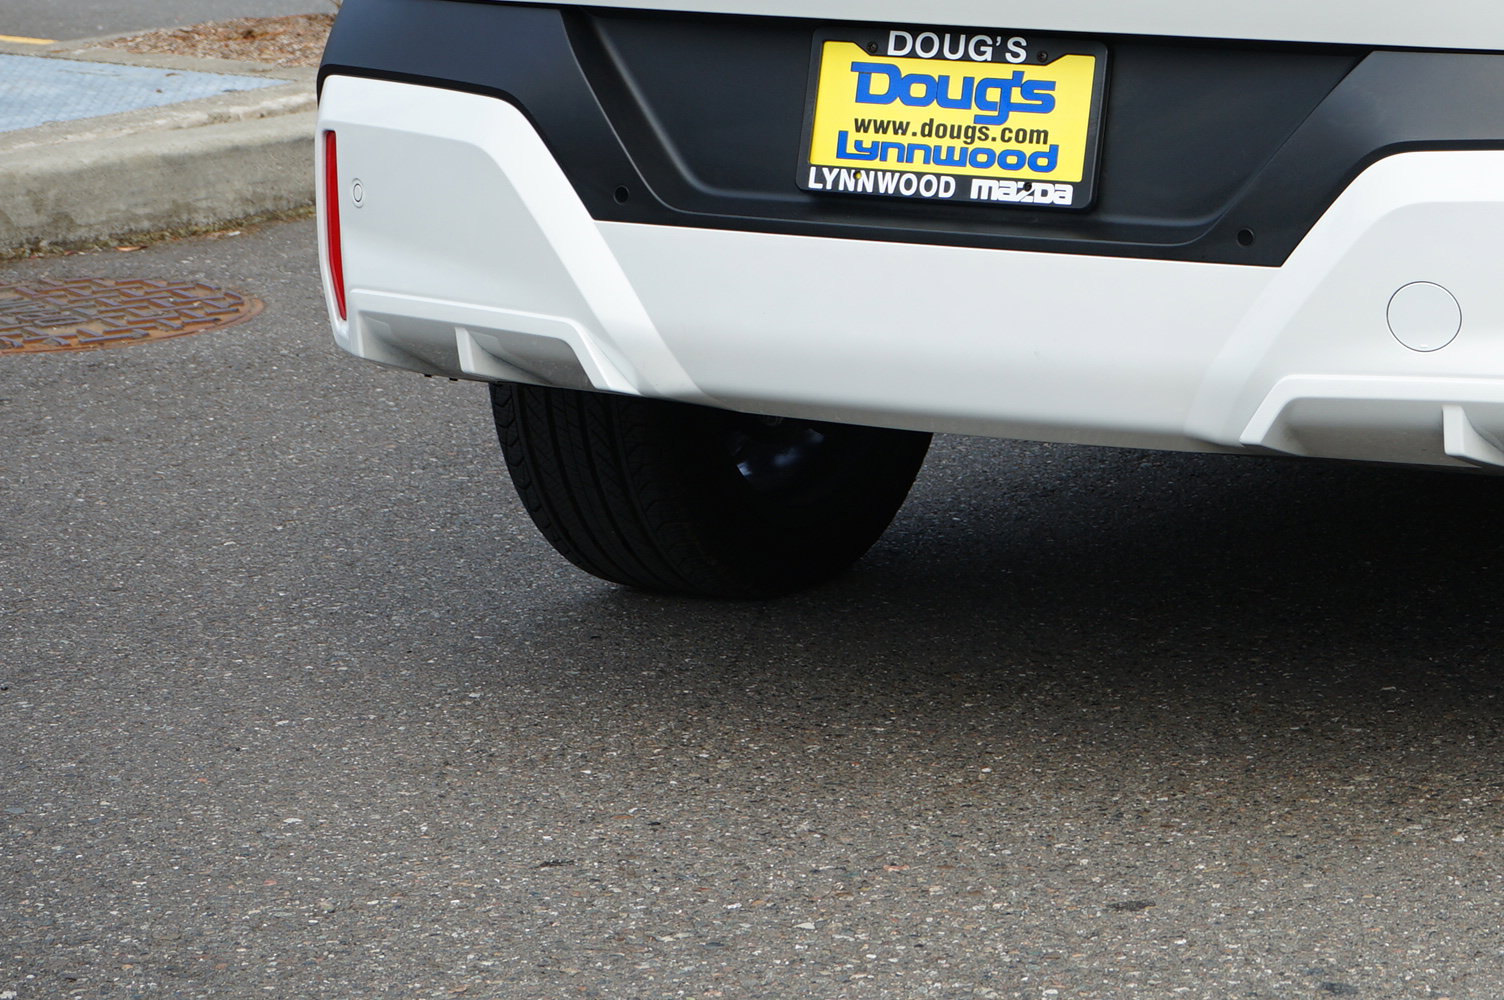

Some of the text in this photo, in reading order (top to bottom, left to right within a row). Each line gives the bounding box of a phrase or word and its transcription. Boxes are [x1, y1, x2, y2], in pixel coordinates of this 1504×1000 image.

[887, 30, 1028, 64] DOUG'S
[850, 61, 1057, 126] Doug's
[854, 117, 1050, 145] www.dougs.com
[836, 130, 1060, 173] Lynnwood
[808, 166, 1074, 206] LYNNWOOD mazda
